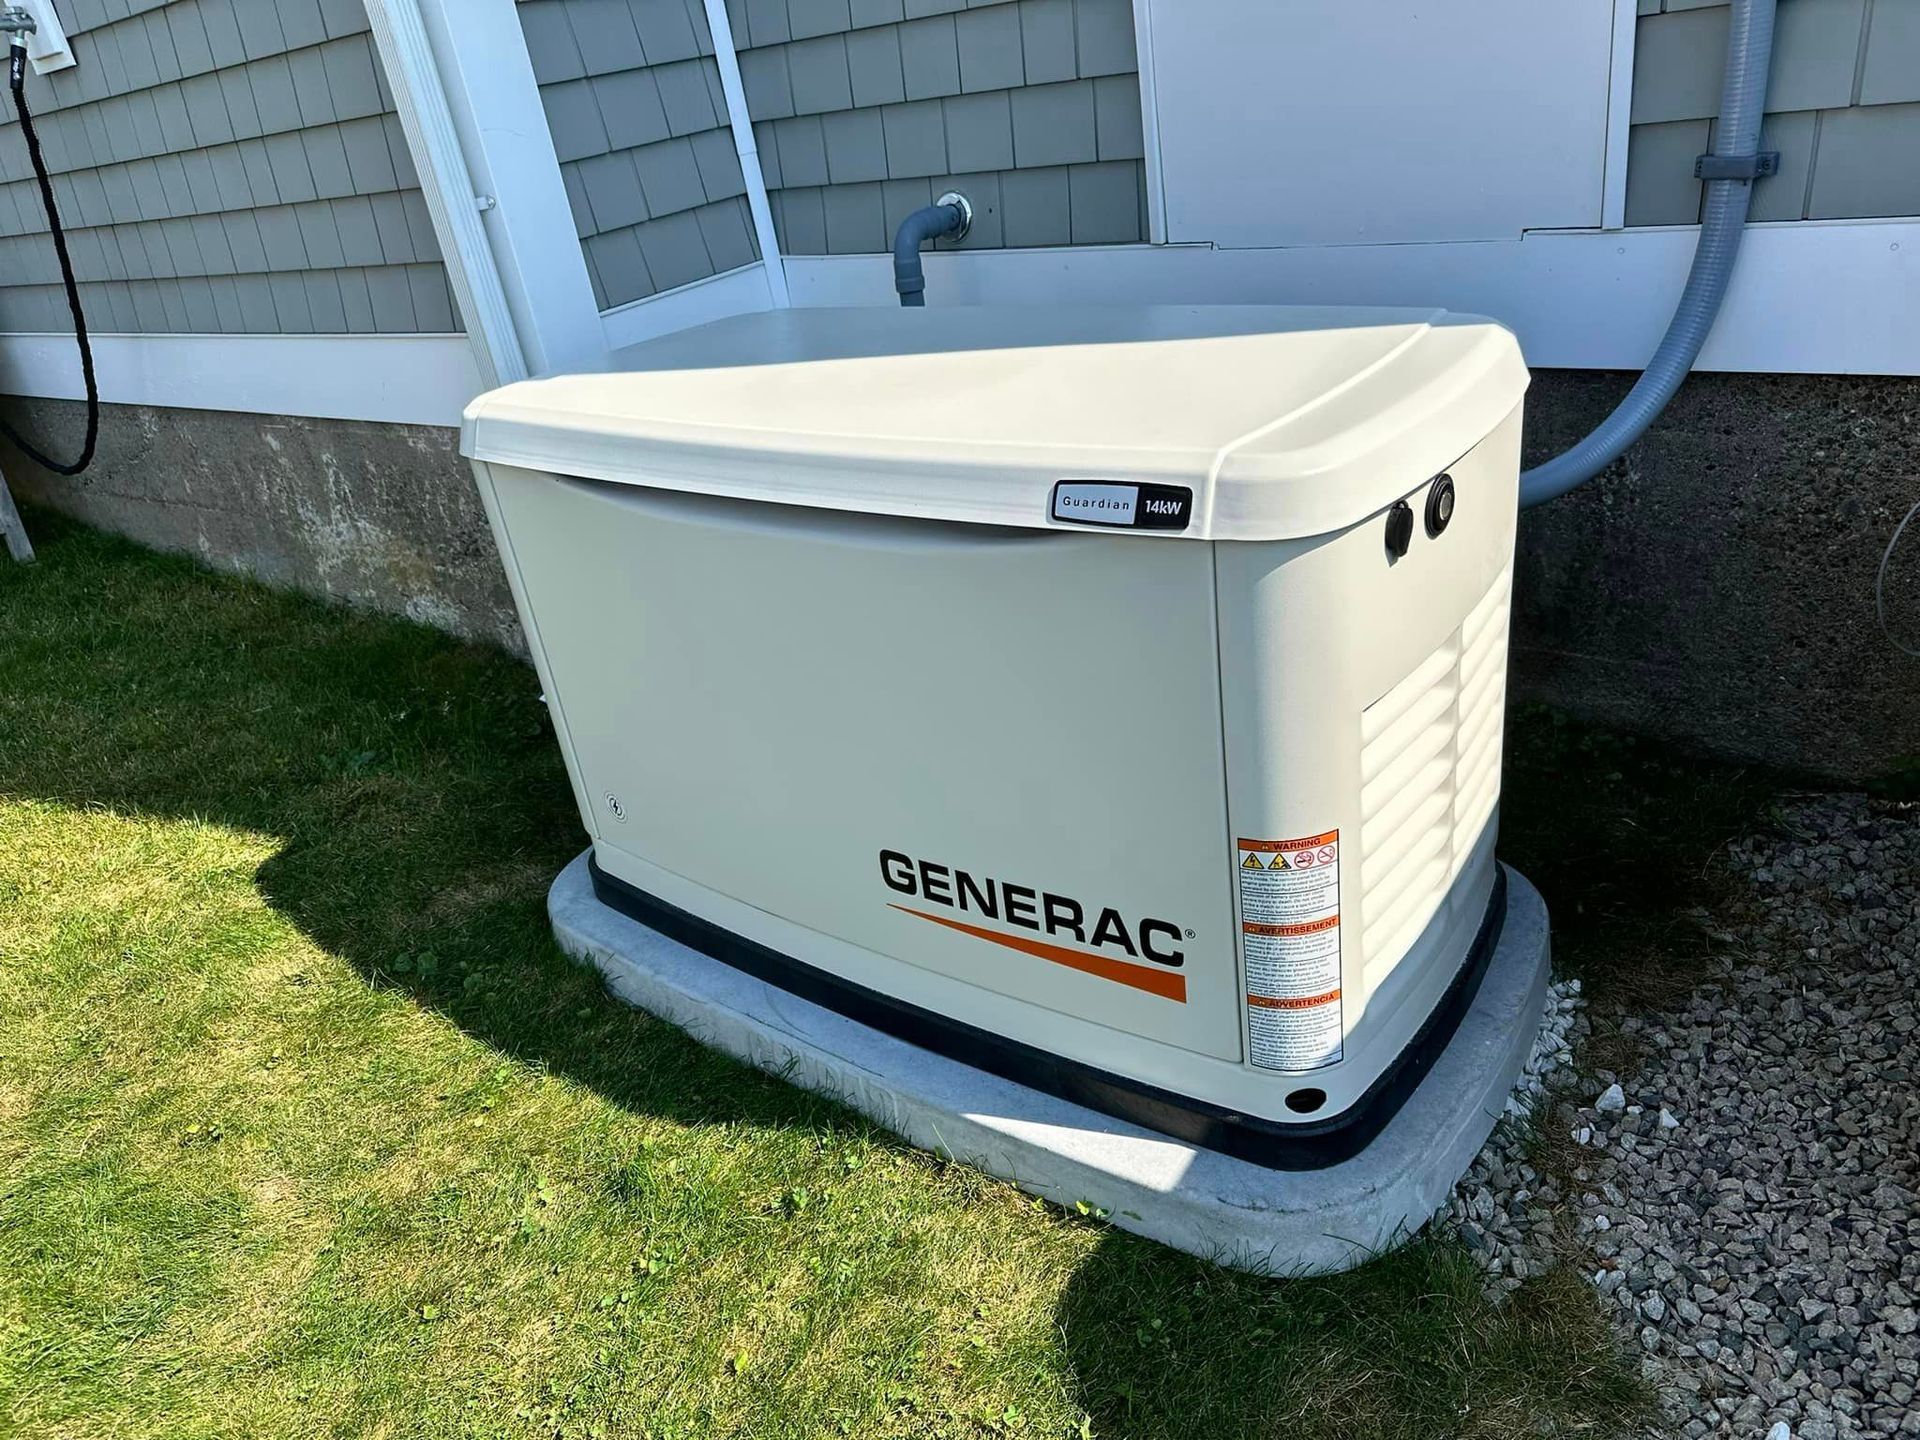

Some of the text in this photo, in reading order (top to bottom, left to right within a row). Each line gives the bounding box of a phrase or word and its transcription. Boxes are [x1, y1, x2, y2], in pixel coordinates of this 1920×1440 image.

[1063, 496, 1182, 515] Guardian 14kW
[1273, 838, 1321, 850] WARNING
[1259, 918, 1337, 935] AVERTISSEMENT
[1269, 993, 1335, 1008] ADVERTENCIA
